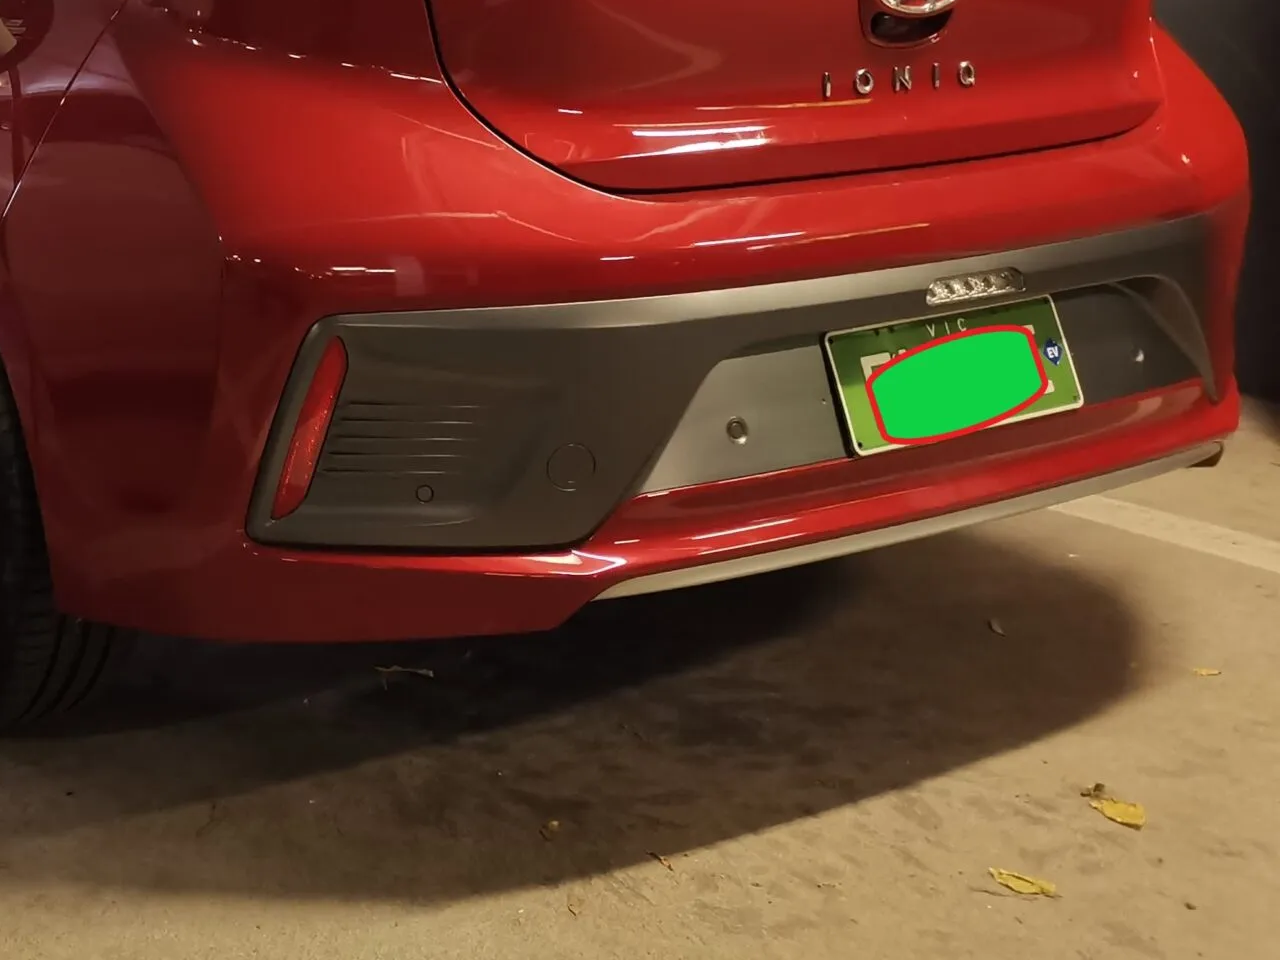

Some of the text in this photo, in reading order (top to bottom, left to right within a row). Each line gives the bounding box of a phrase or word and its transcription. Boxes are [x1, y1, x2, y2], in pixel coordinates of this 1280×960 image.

[823, 60, 976, 98] IONIQ
[925, 318, 966, 336] VIC
[1046, 345, 1059, 359] EV
